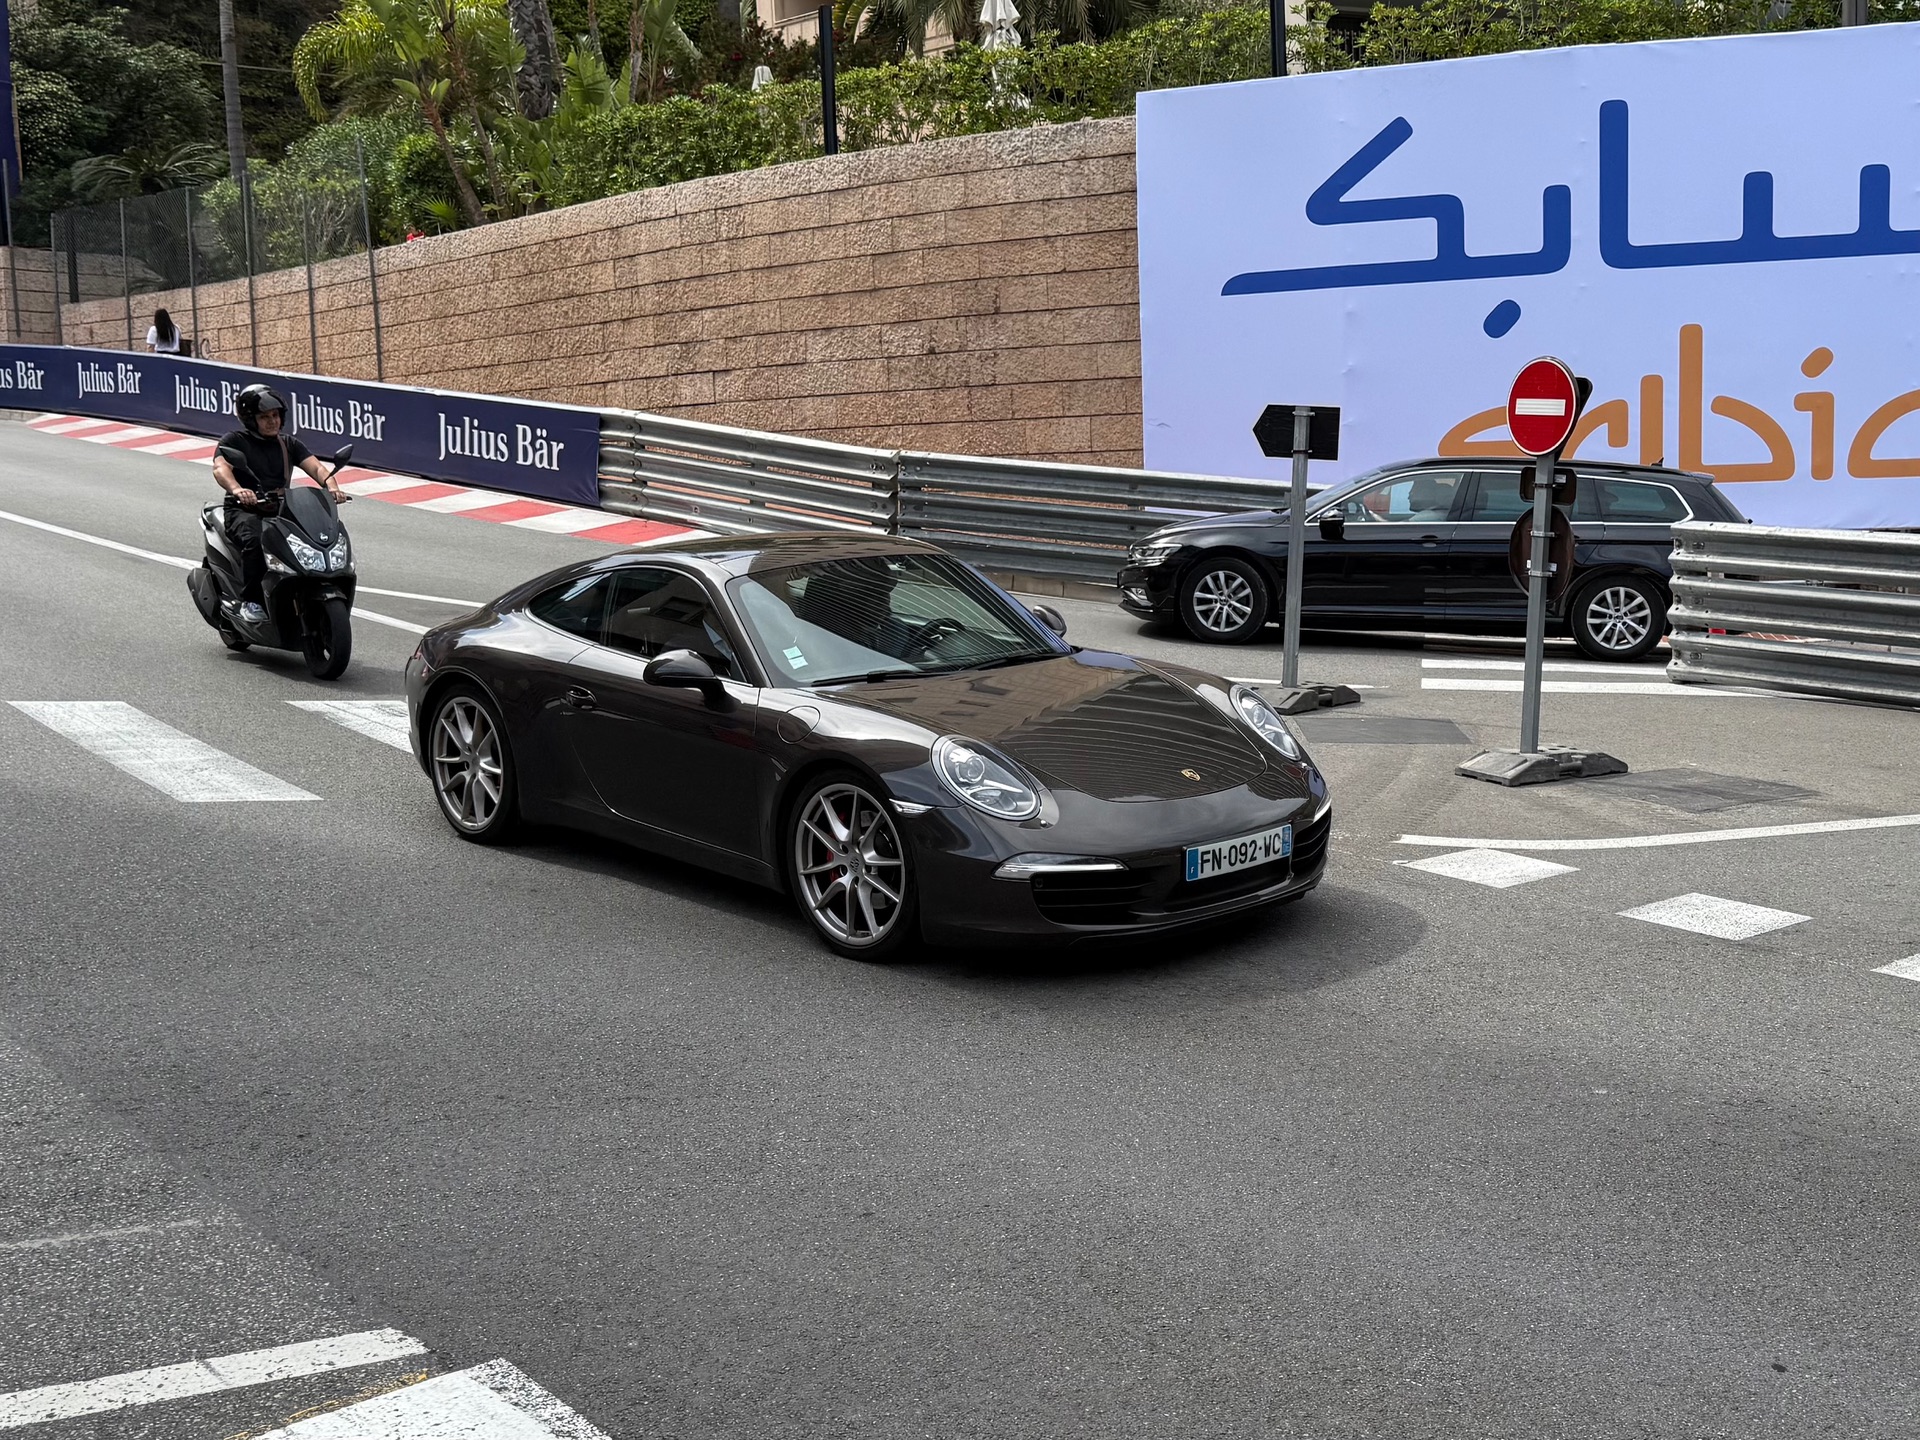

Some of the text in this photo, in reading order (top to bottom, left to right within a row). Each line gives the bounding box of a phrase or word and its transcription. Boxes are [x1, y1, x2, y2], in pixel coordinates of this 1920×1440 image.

[16, 361, 44, 390] Bär
[77, 362, 142, 399] Julius Bär
[174, 374, 240, 417] Julius Bä
[291, 392, 386, 441] Julius Bär
[438, 412, 565, 471] Julius Bär
